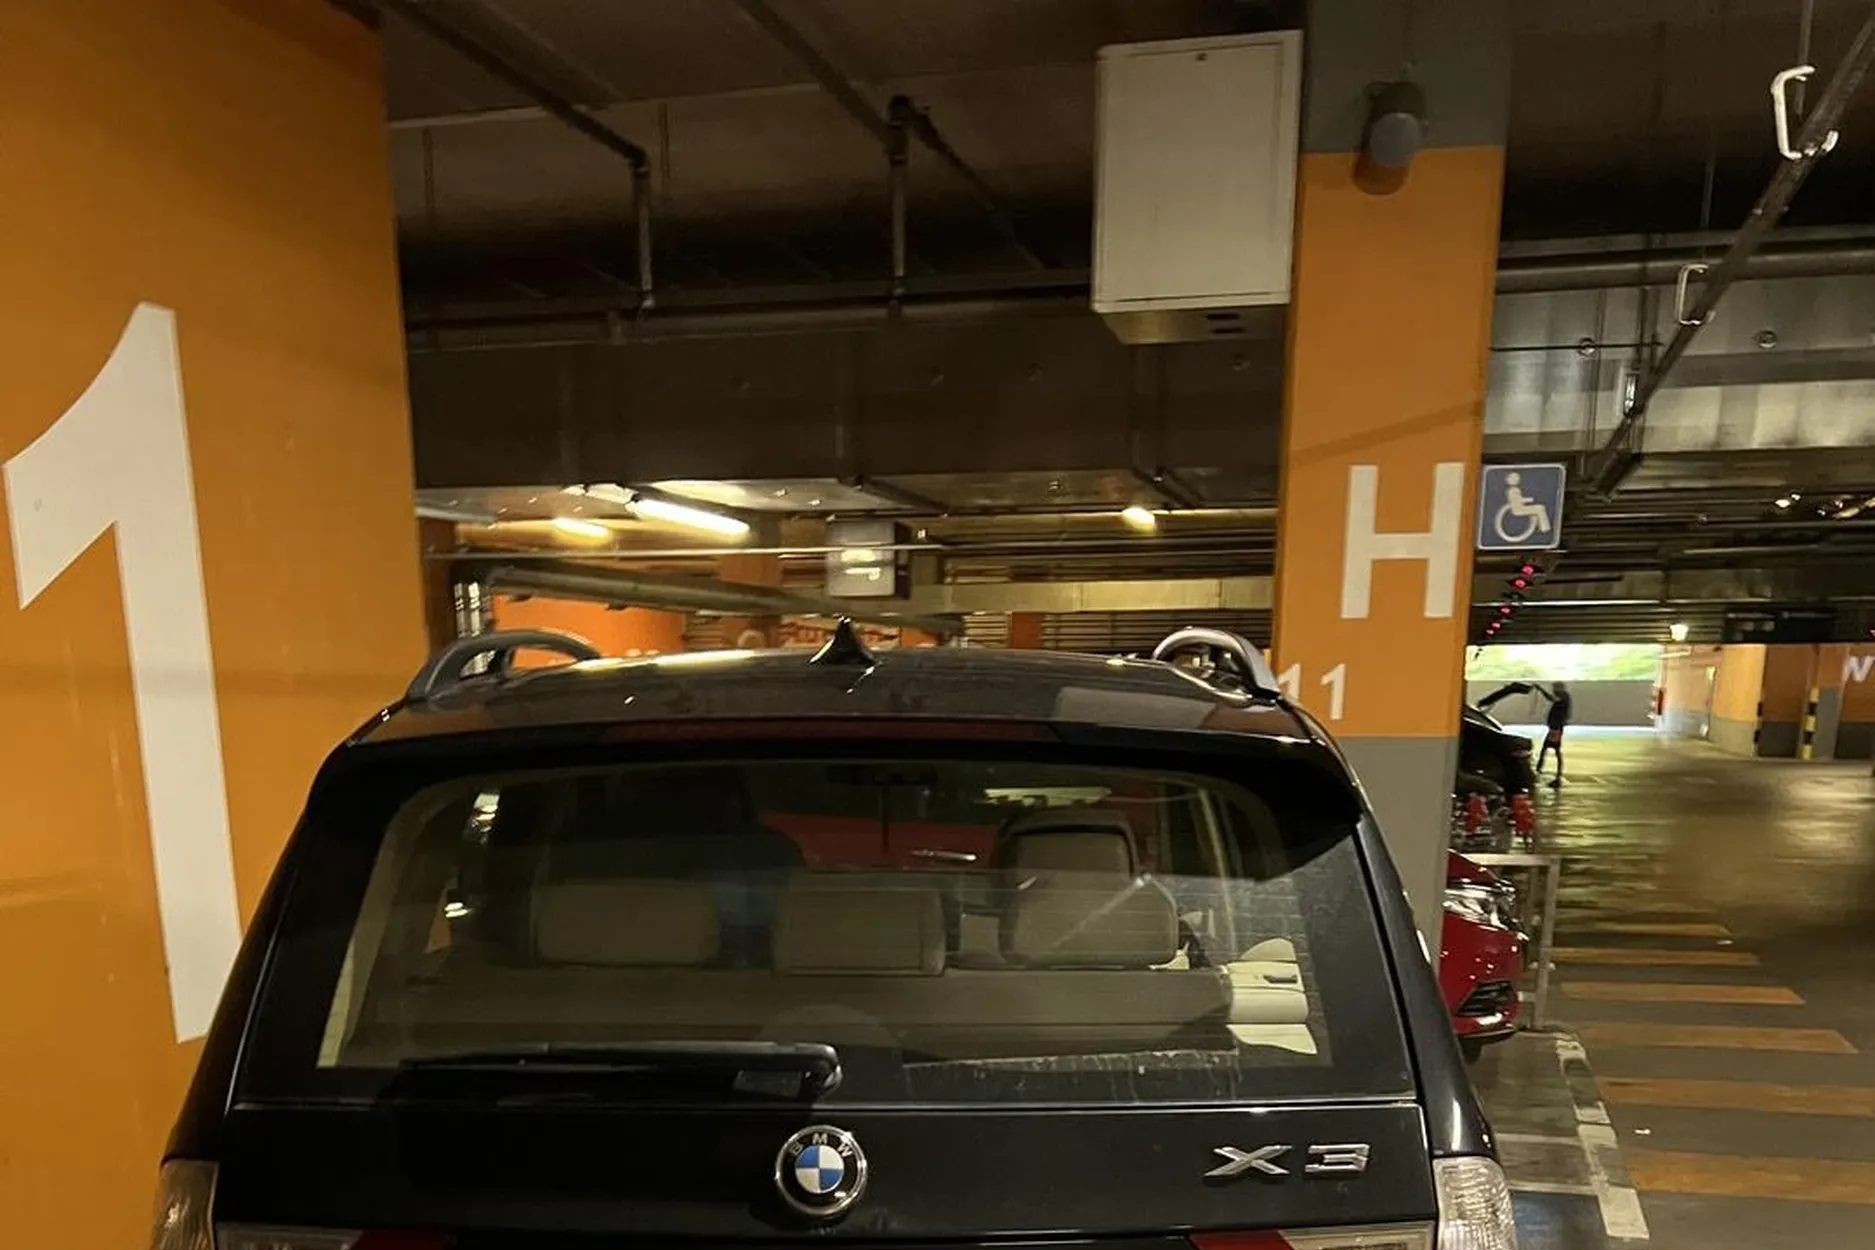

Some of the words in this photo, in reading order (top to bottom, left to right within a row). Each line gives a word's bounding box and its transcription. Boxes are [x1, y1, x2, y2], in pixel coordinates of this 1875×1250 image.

[1340, 462, 1465, 619] H
[3, 301, 244, 1044] 1
[1278, 662, 1346, 720] 11
[788, 1132, 853, 1158] BMW
[1203, 1143, 1371, 1177] X3
